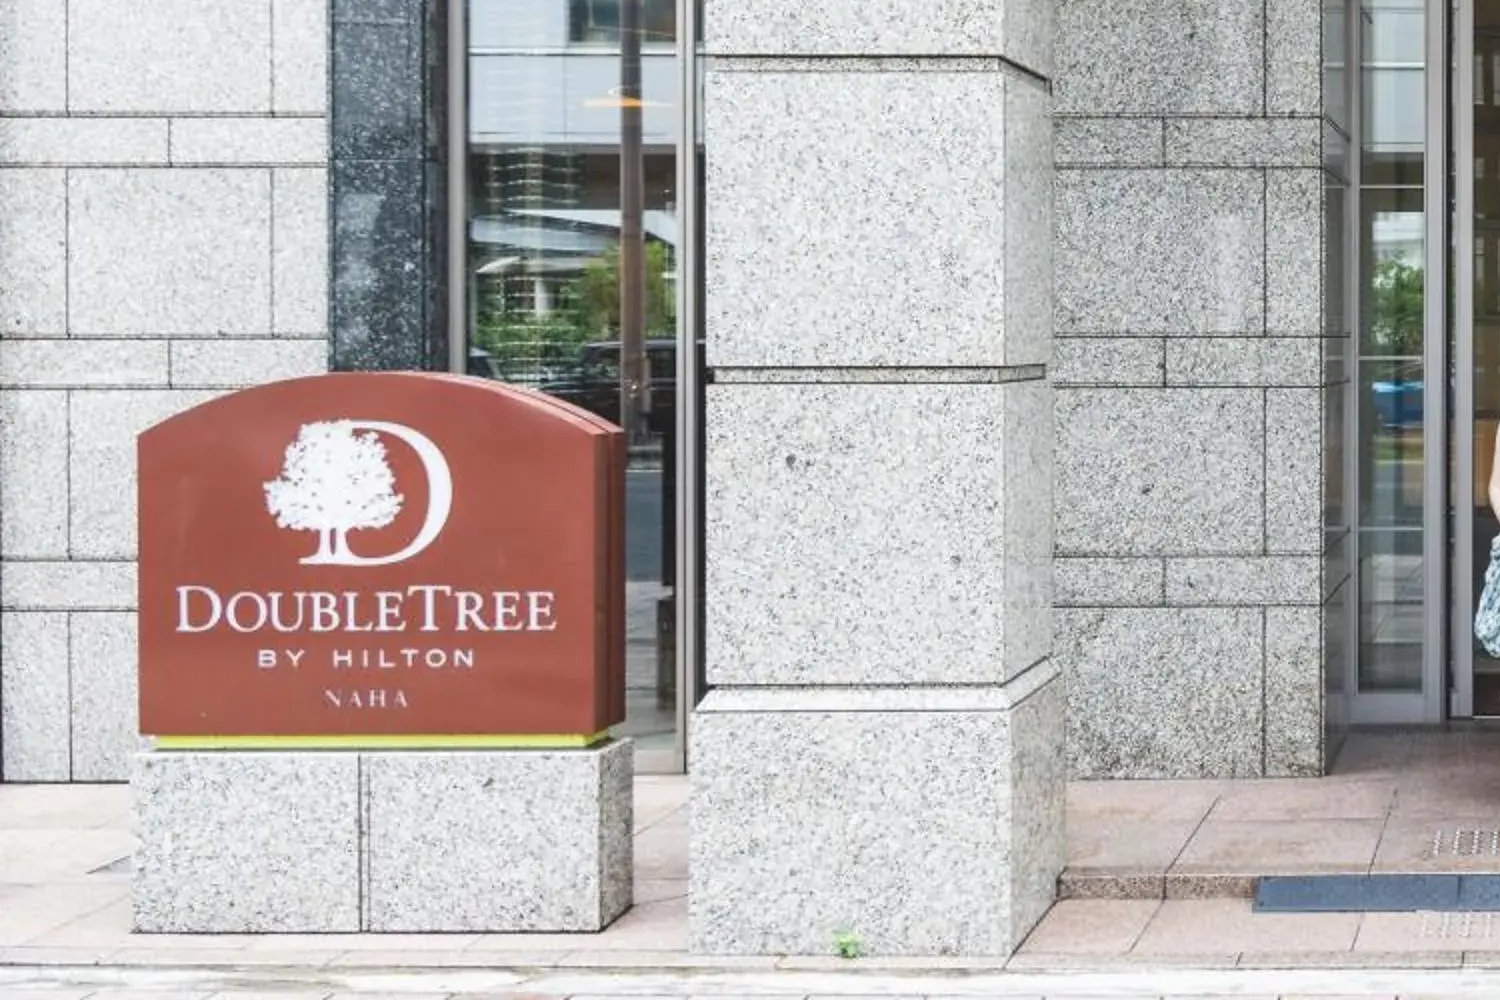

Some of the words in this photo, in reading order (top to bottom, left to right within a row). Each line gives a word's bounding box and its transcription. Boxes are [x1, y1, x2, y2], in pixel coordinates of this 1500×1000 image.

[175, 584, 558, 633] DOUBLETREE
[257, 648, 305, 668] BY
[332, 648, 475, 668] HILTON
[325, 688, 409, 709] NAHA
